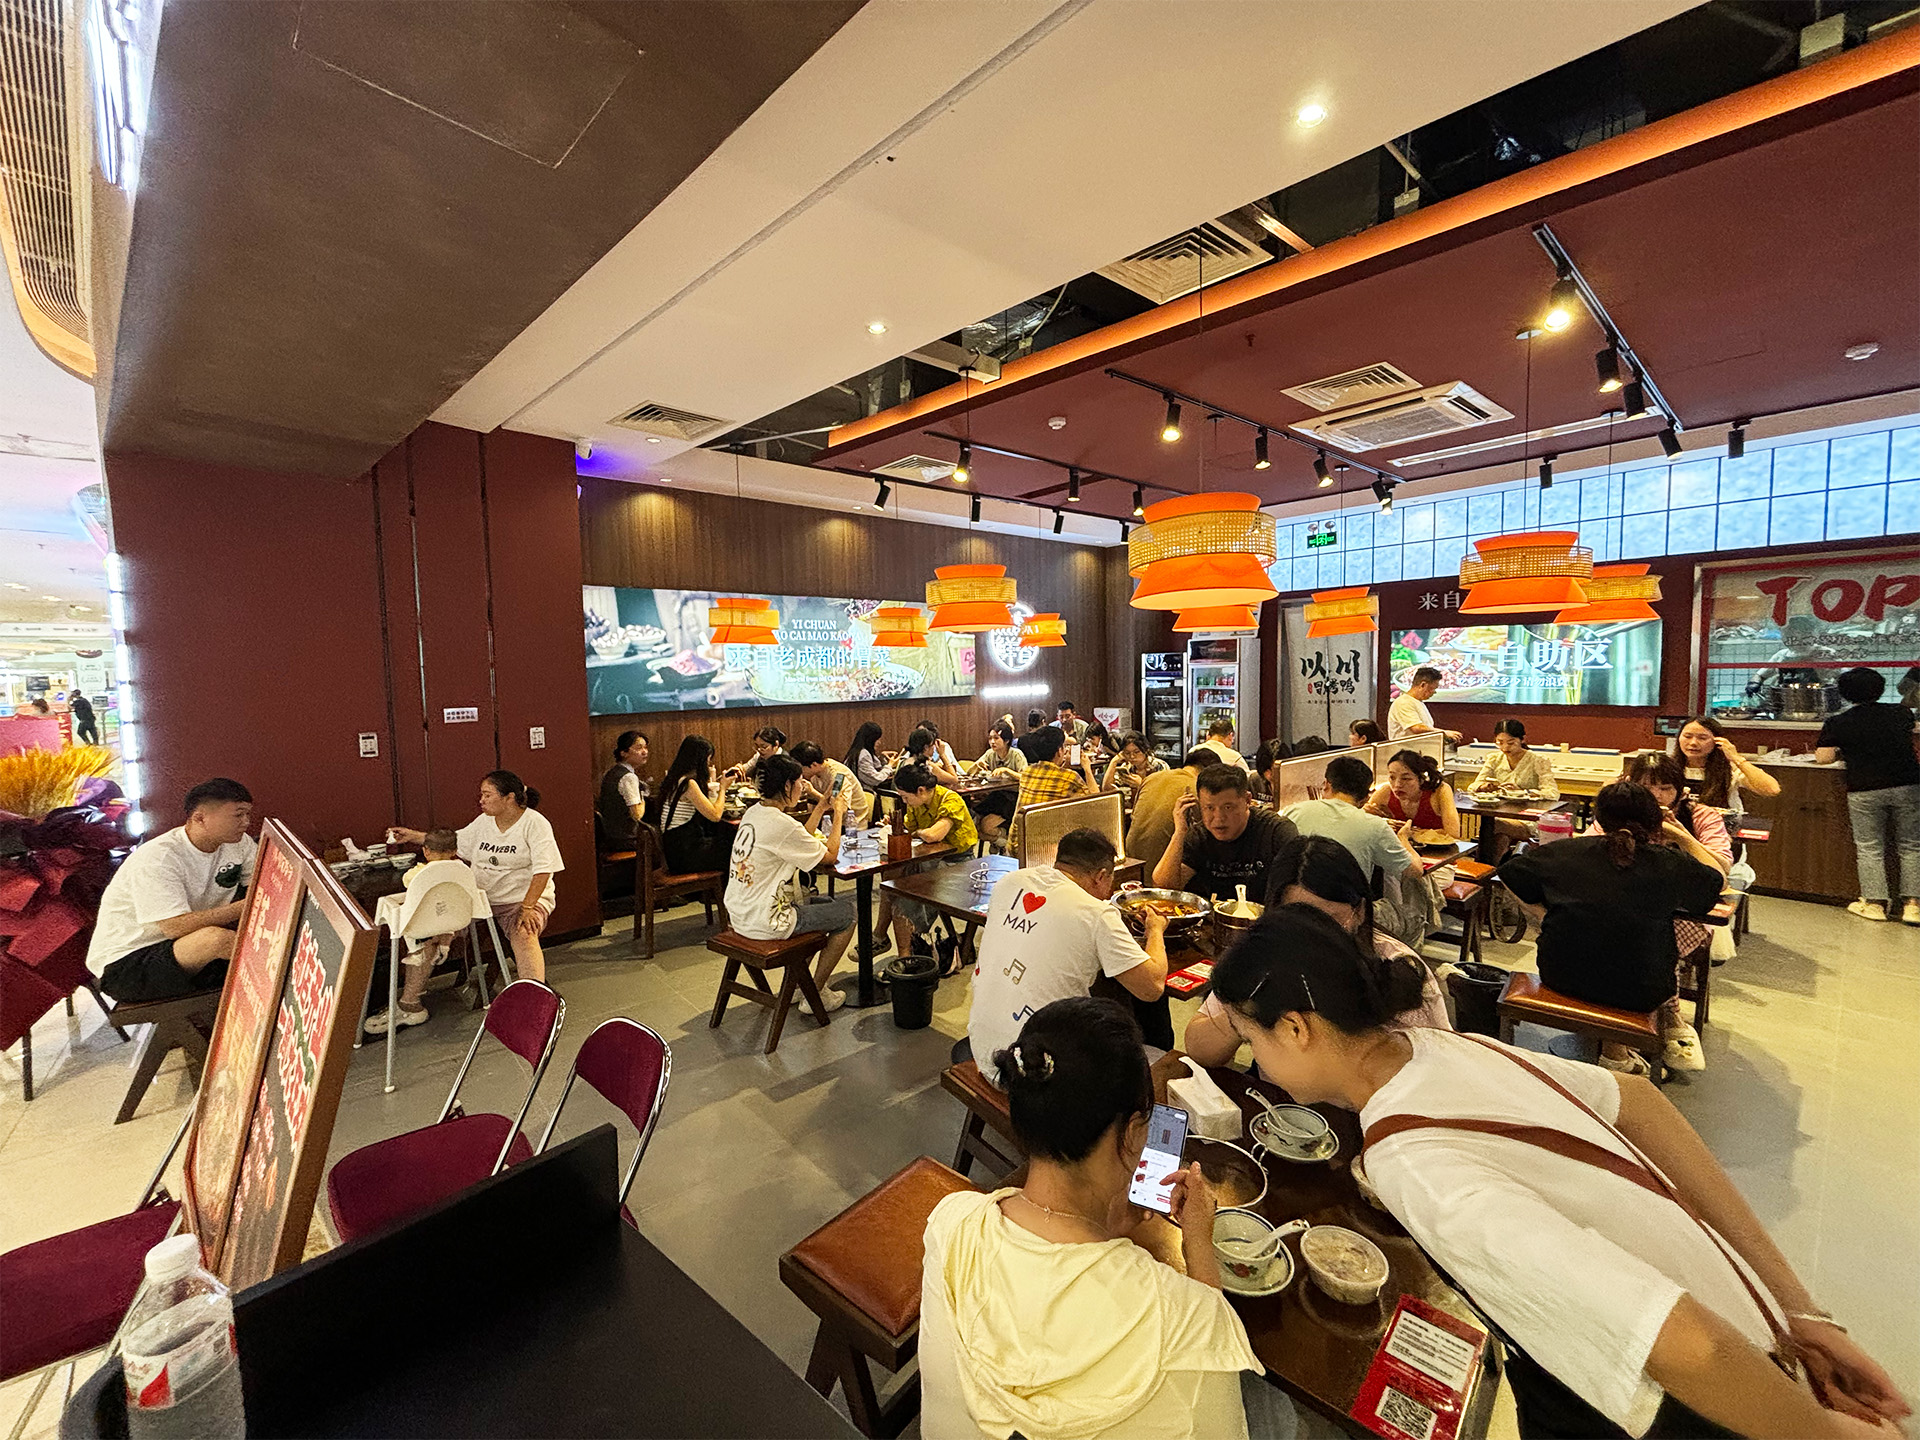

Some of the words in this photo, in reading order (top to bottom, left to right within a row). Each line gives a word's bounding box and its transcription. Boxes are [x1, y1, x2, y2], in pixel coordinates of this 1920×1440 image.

[1418, 591, 1461, 611] 来自
[1755, 574, 1920, 627] TOP
[791, 619, 803, 629] YI
[804, 619, 837, 630] CHUAN
[789, 630, 807, 641] CAI
[807, 631, 829, 641] MAO
[830, 631, 848, 641] KAO
[728, 645, 891, 670] 来自老成都的冒菜
[1299, 649, 1361, 682] 以川
[1424, 637, 1614, 673] 一元自助区
[479, 841, 517, 854] BRAVEBR
[1011, 888, 1024, 910] I
[1003, 913, 1038, 934] MAY
